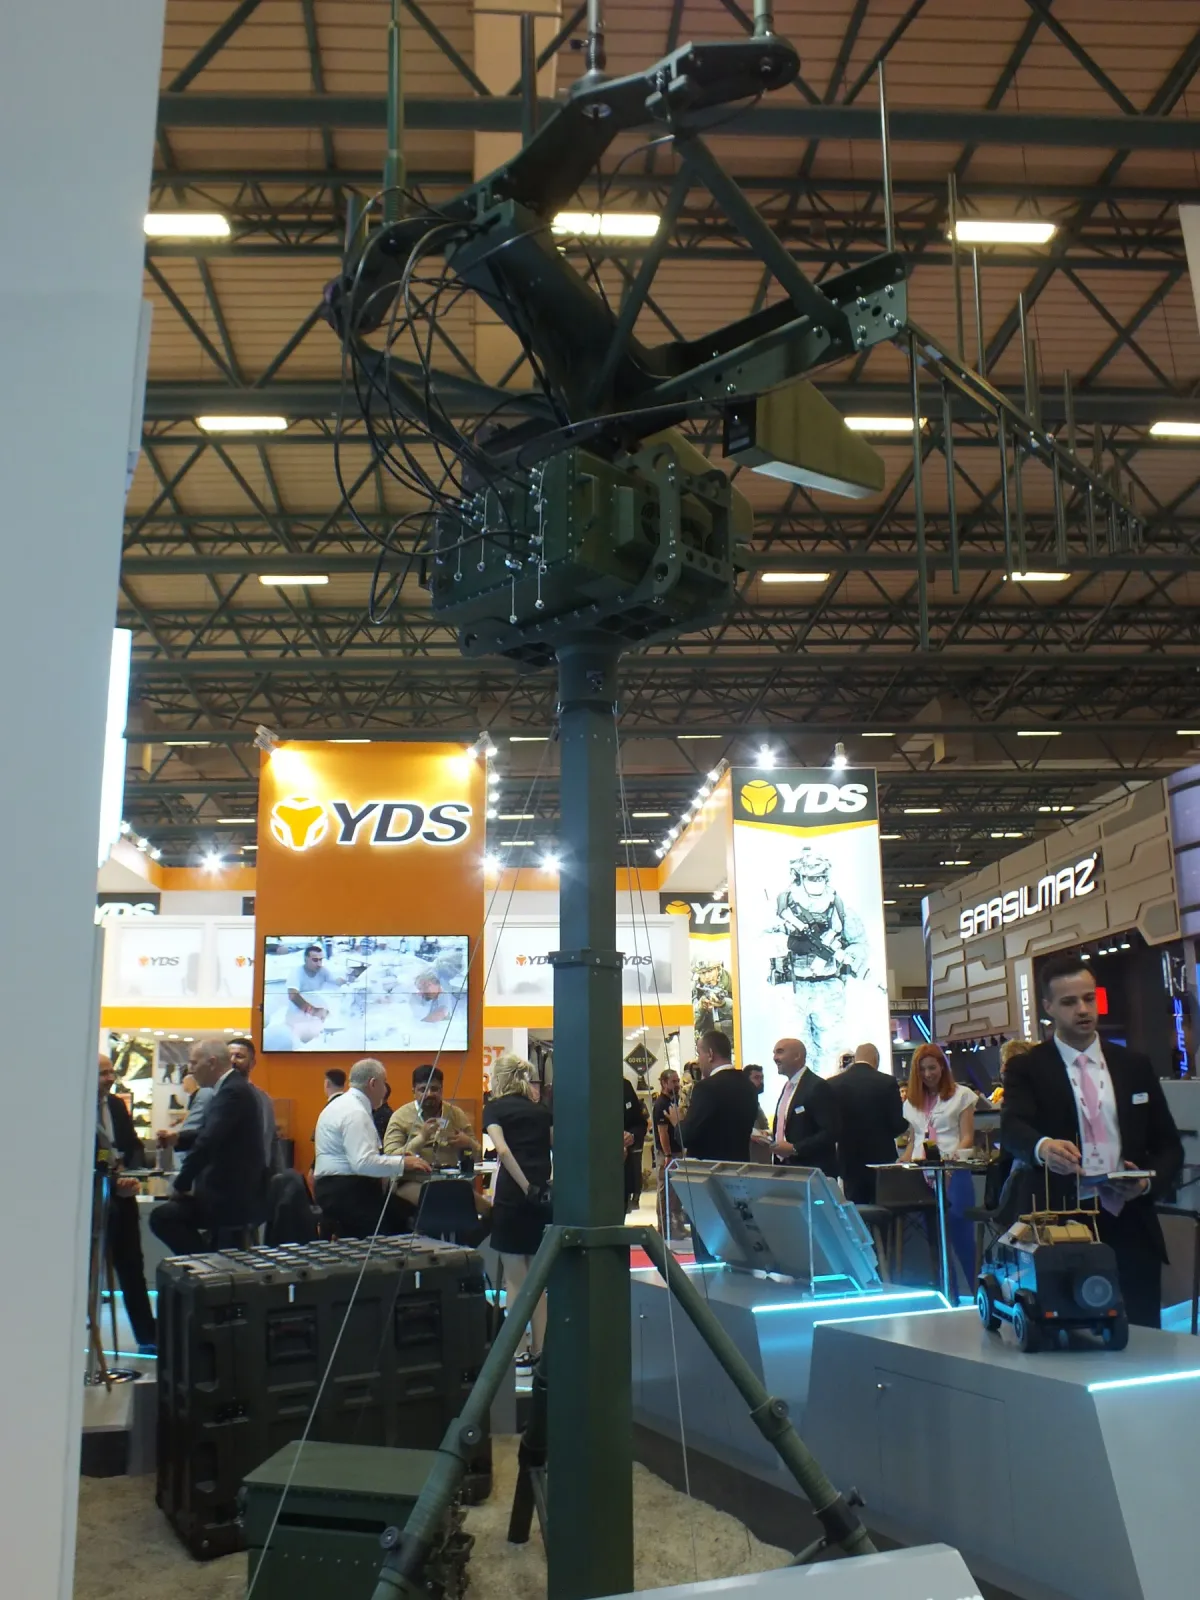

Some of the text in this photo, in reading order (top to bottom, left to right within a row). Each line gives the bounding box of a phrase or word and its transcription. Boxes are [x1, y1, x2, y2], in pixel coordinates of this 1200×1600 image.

[776, 783, 868, 813] YDS
[331, 802, 472, 844] YDS
[960, 856, 1096, 939] SARSILMAZ
[690, 903, 730, 925] YD
[151, 956, 180, 967] YDS
[528, 955, 550, 966] YD
[1174, 998, 1188, 1077] ILMAZ
